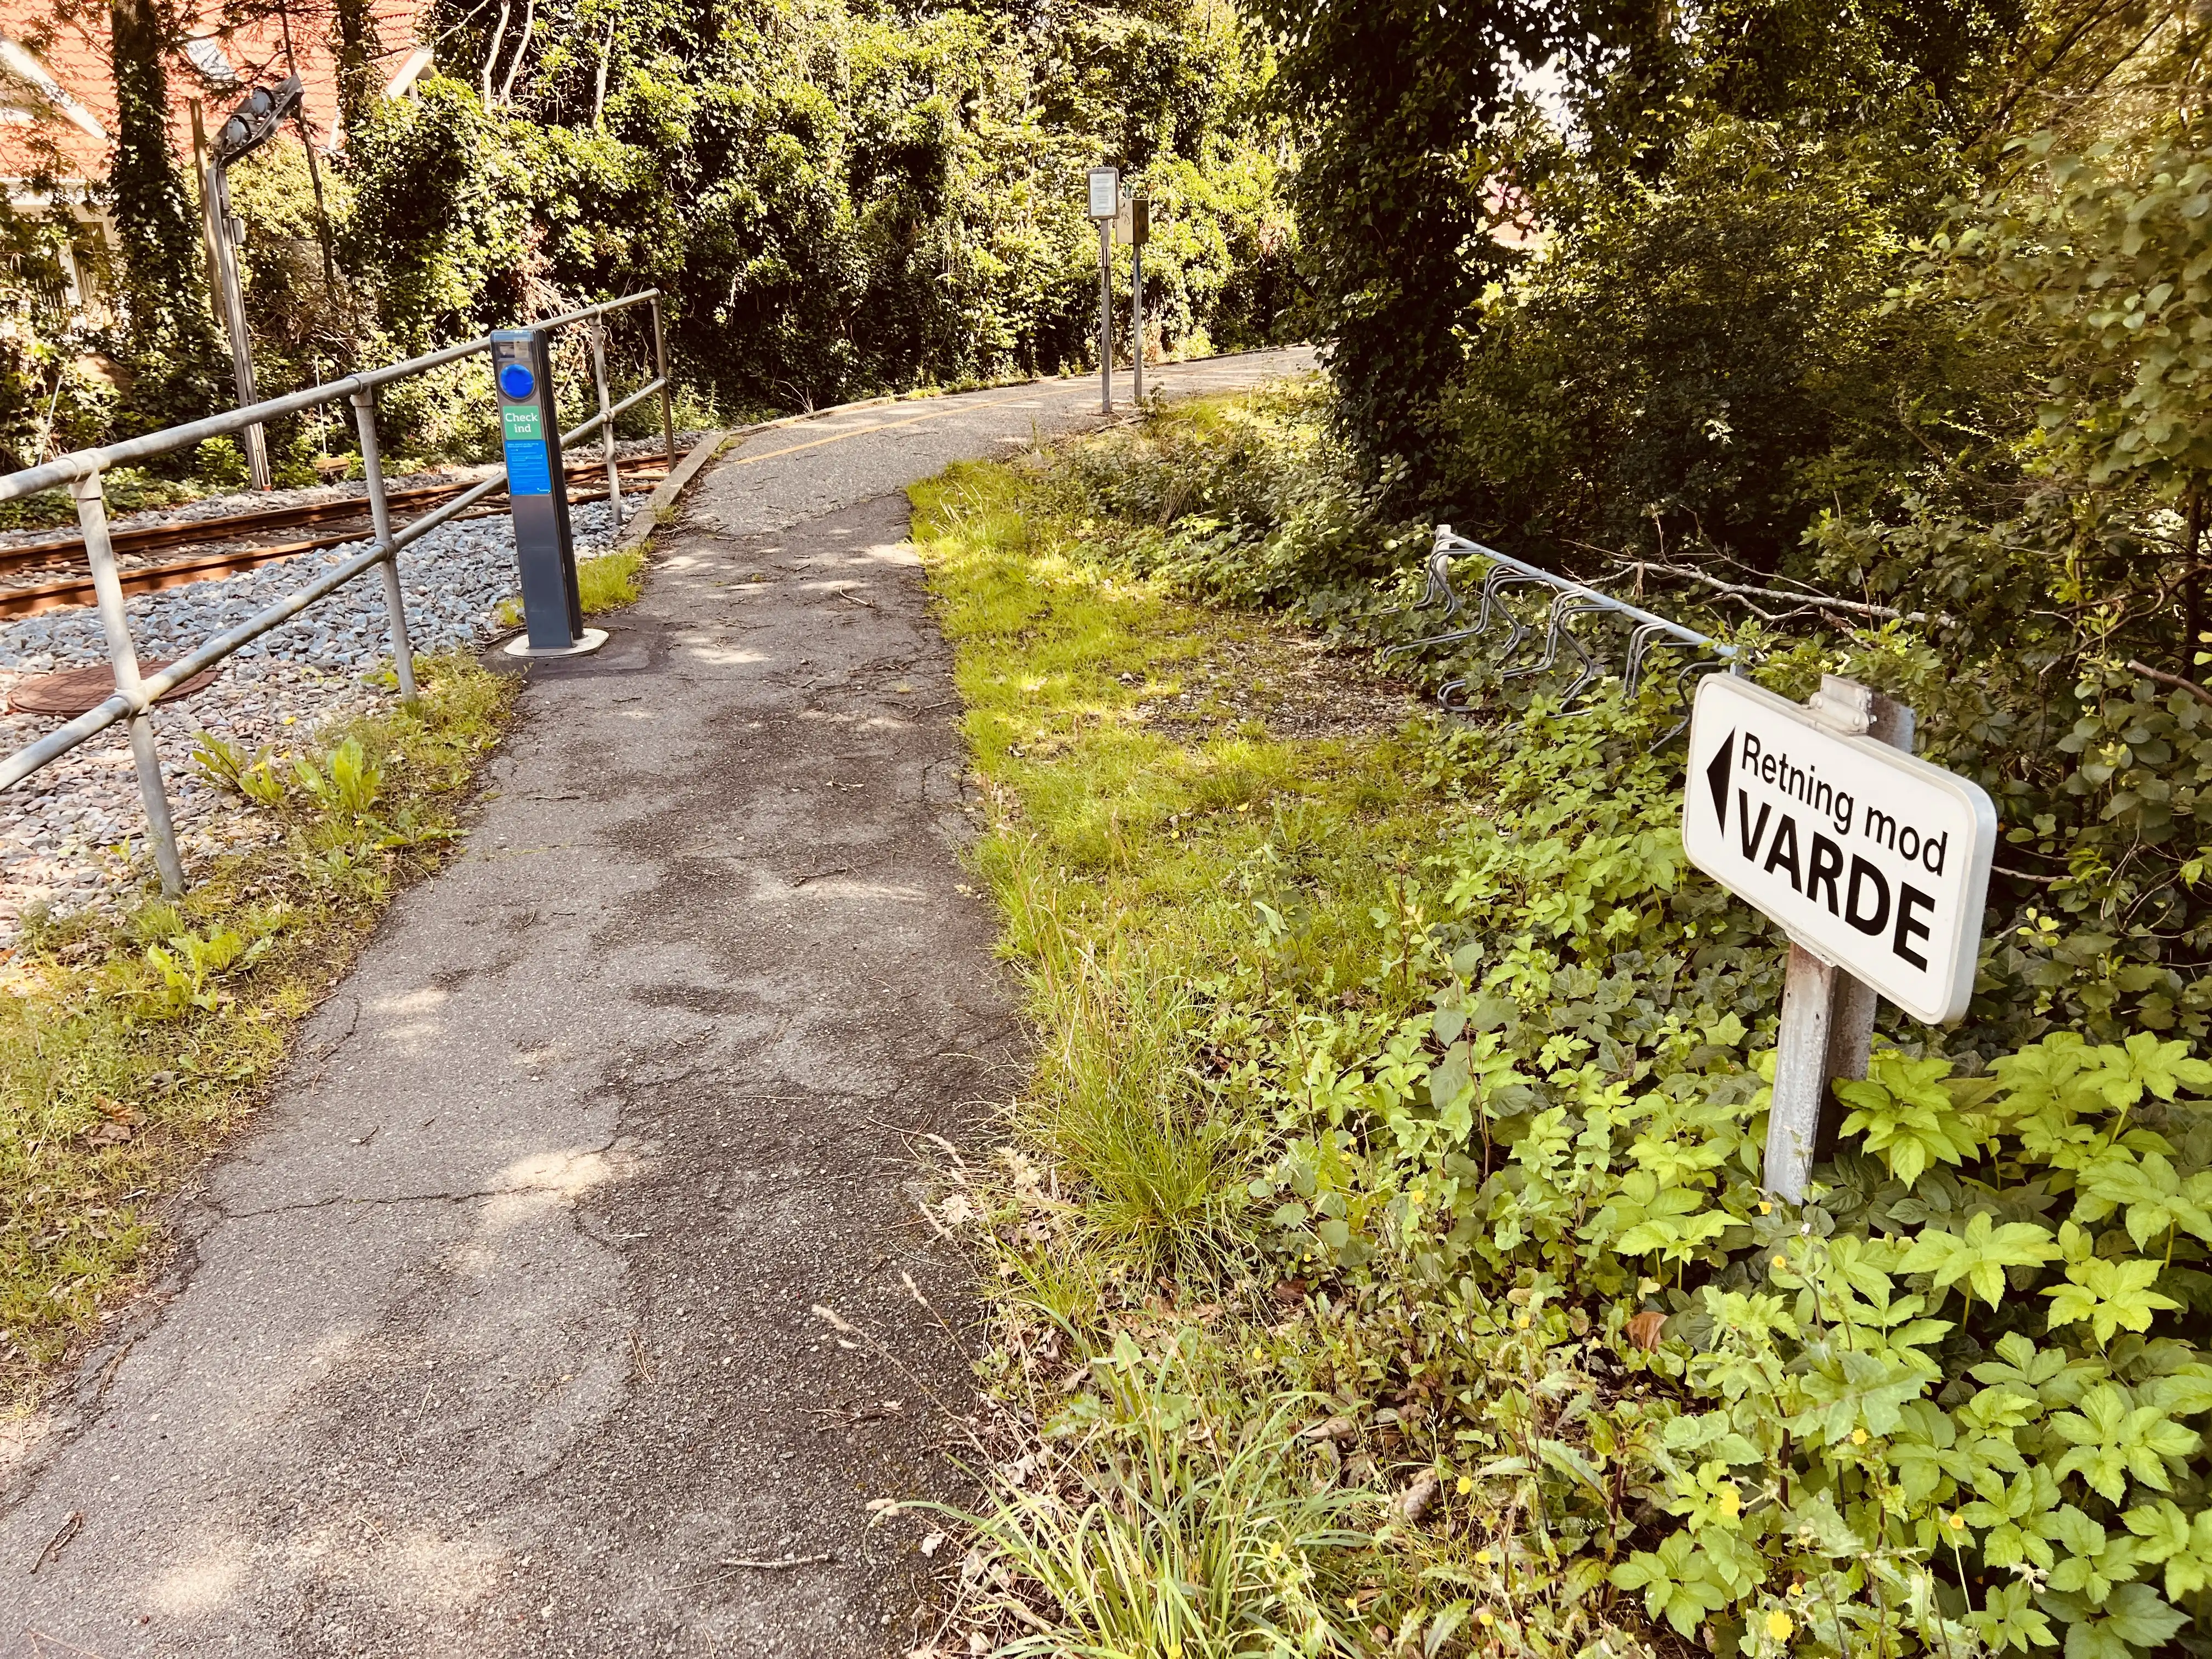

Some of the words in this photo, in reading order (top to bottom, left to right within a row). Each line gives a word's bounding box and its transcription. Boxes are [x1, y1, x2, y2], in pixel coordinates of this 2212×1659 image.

[505, 413, 538, 422] Check
[514, 424, 532, 433] ind
[1741, 731, 1854, 835] Retning
[1865, 806, 1949, 877] mod
[1738, 787, 1936, 973] VARDE
